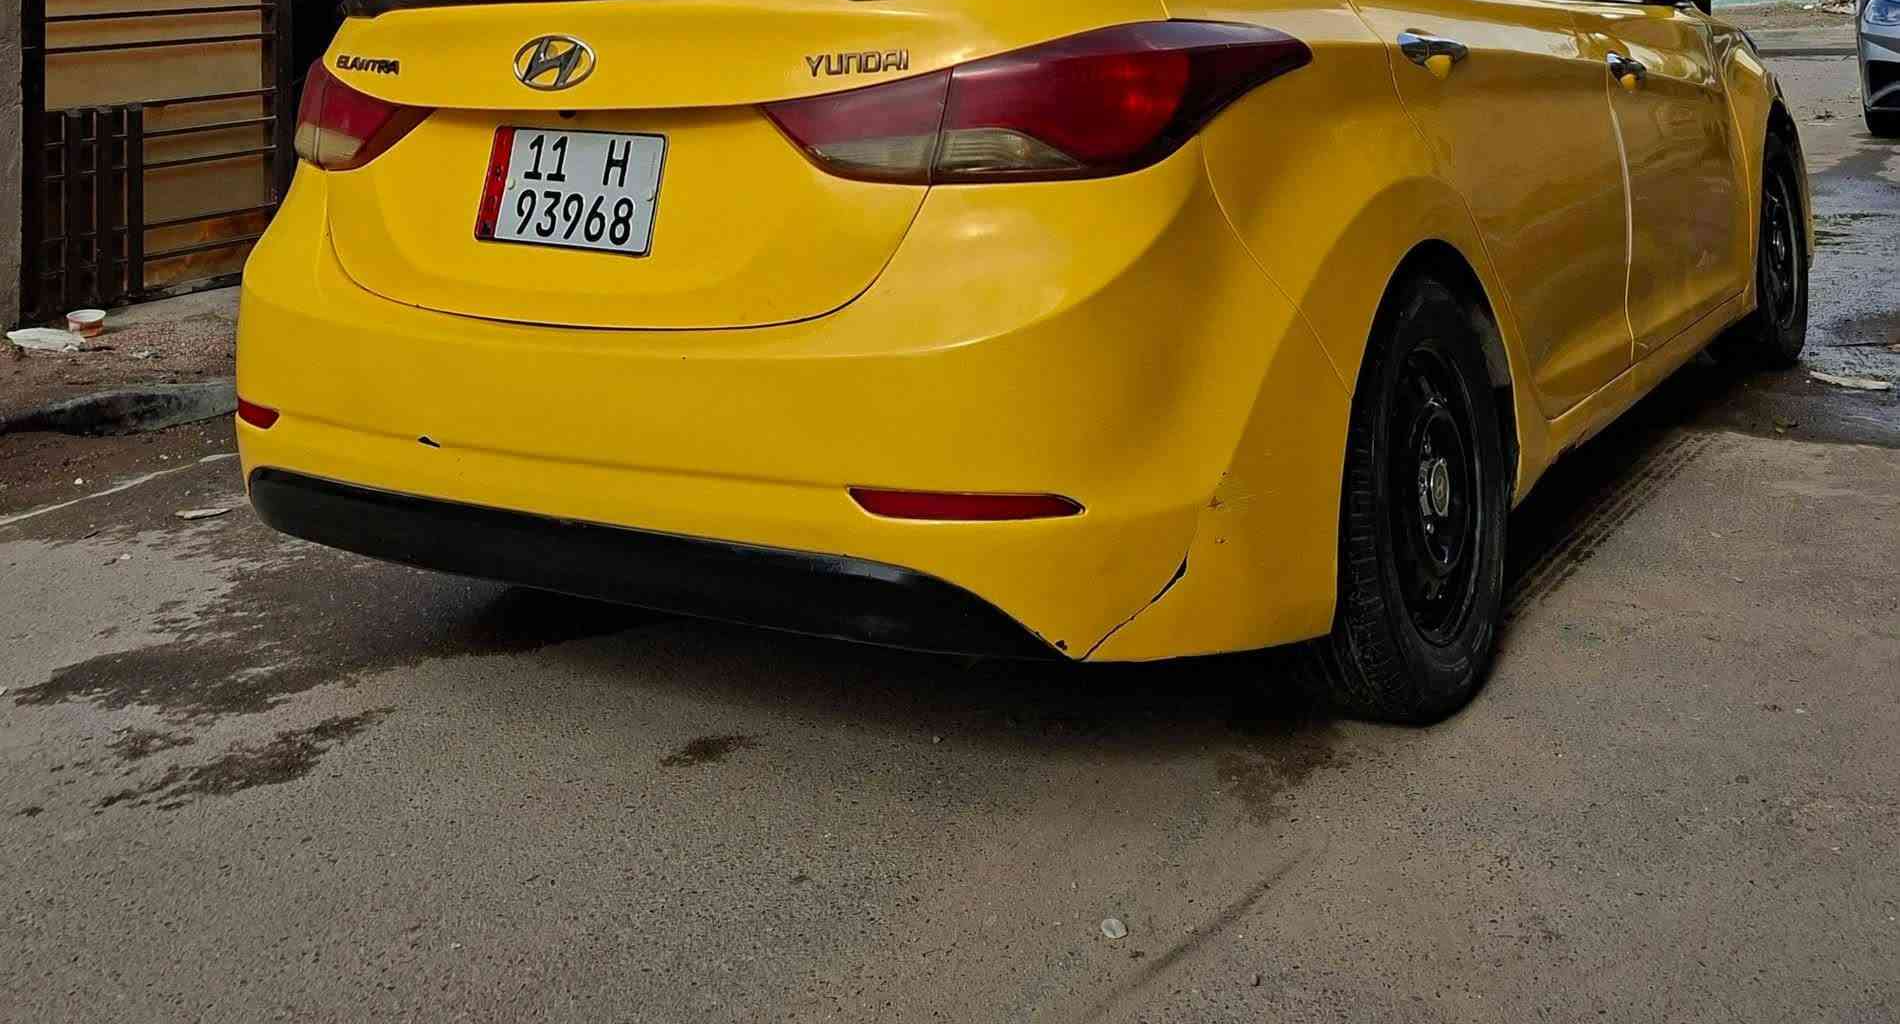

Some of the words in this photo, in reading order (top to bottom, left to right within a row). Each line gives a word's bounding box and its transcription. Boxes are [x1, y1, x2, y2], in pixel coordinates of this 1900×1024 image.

[336, 55, 400, 76] ELANTRA
[805, 49, 909, 78] YUNDAI
[523, 134, 569, 182] 11
[602, 139, 632, 188] H
[516, 189, 634, 246] 93968
